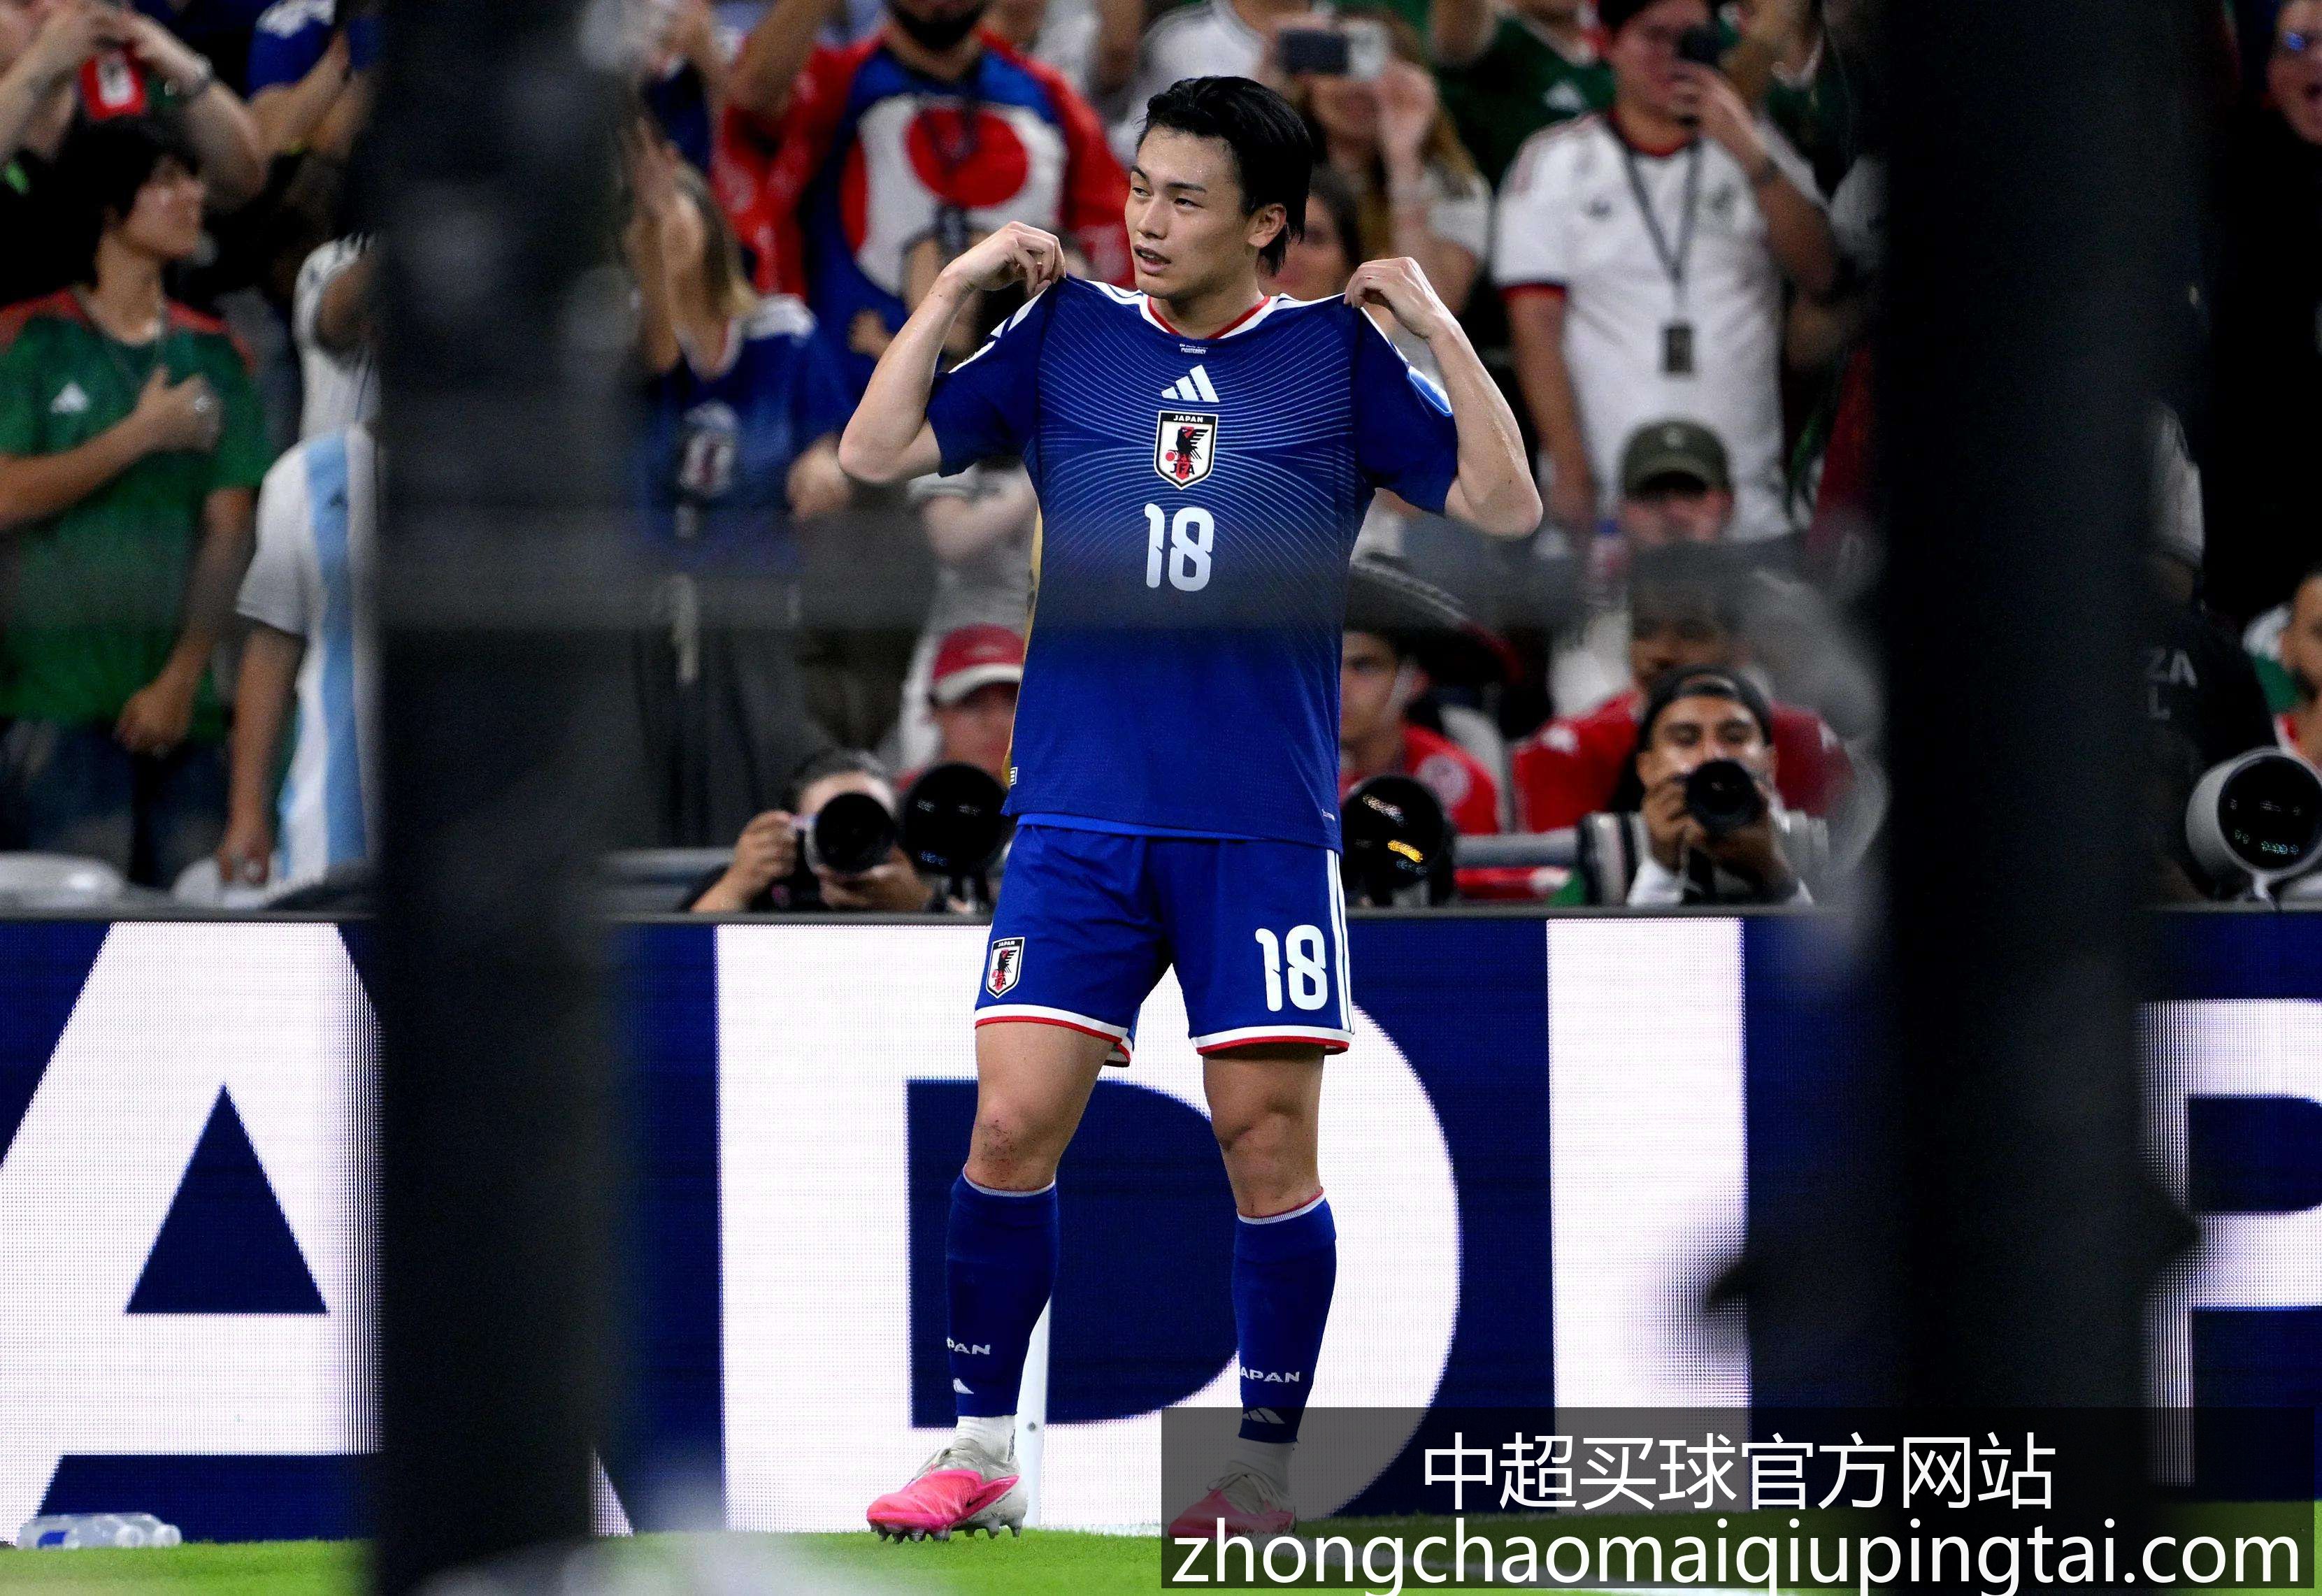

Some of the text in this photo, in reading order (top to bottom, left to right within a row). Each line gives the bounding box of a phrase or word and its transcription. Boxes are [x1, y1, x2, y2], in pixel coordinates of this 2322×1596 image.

[1173, 415, 1203, 423] JAPAN
[1170, 463, 1195, 475] JFA
[1144, 502, 1214, 591] 18
[1255, 924, 1328, 1012] 18
